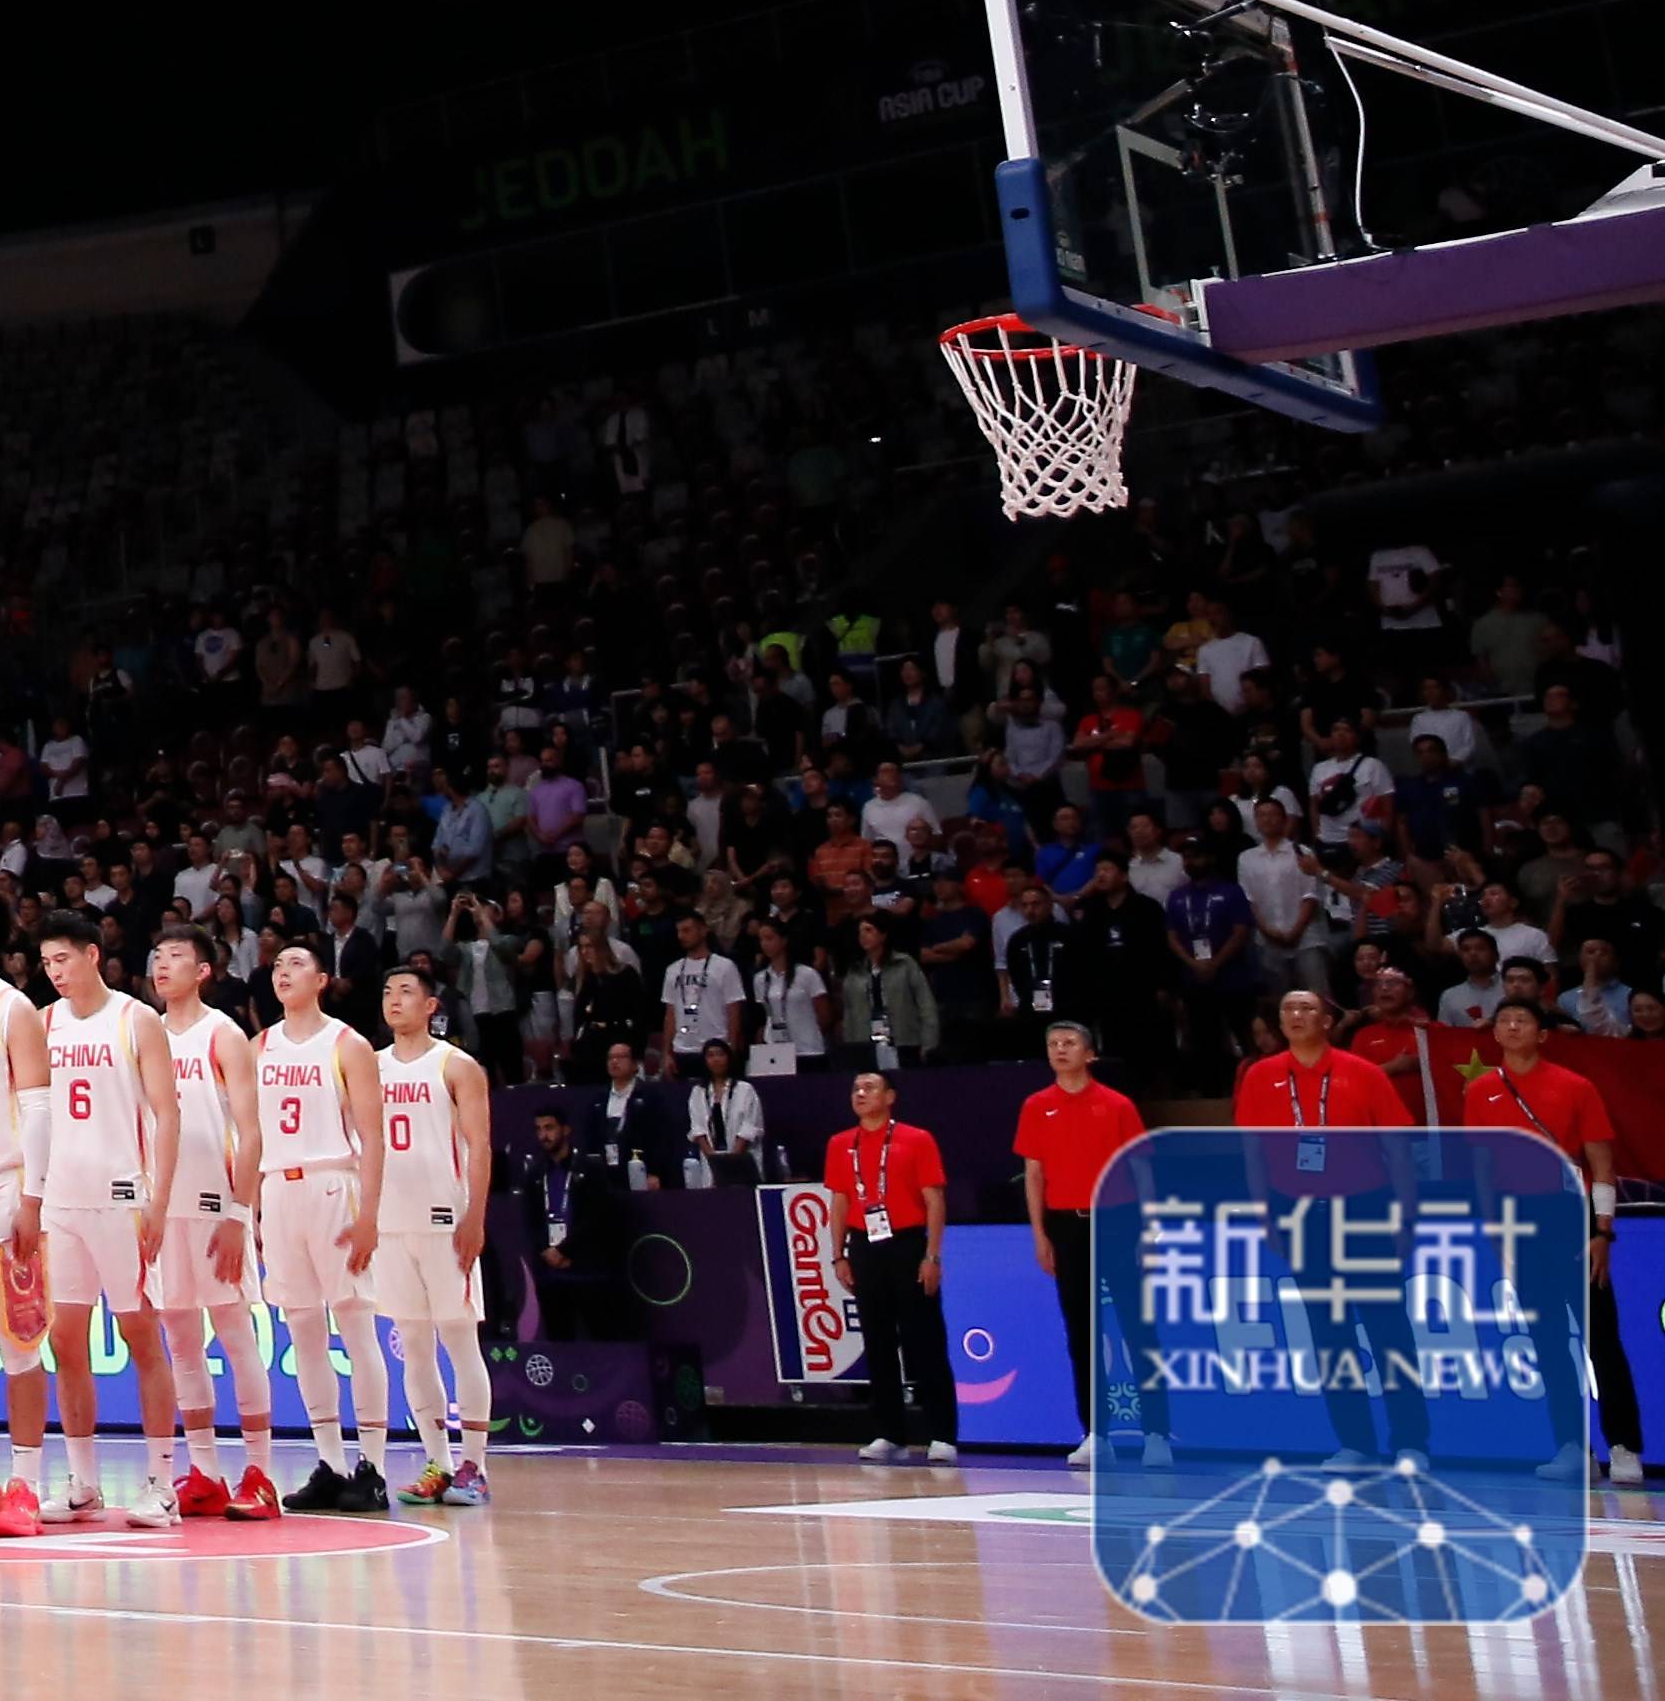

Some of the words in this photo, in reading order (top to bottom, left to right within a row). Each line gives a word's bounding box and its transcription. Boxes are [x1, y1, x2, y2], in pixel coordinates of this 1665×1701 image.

[50, 1044, 114, 1069] CHINA
[262, 1064, 323, 1087] CHINA
[69, 1078, 92, 1121] 6
[381, 1081, 431, 1105] HINA
[280, 1096, 303, 1135] 3
[388, 1113, 412, 1152] 0
